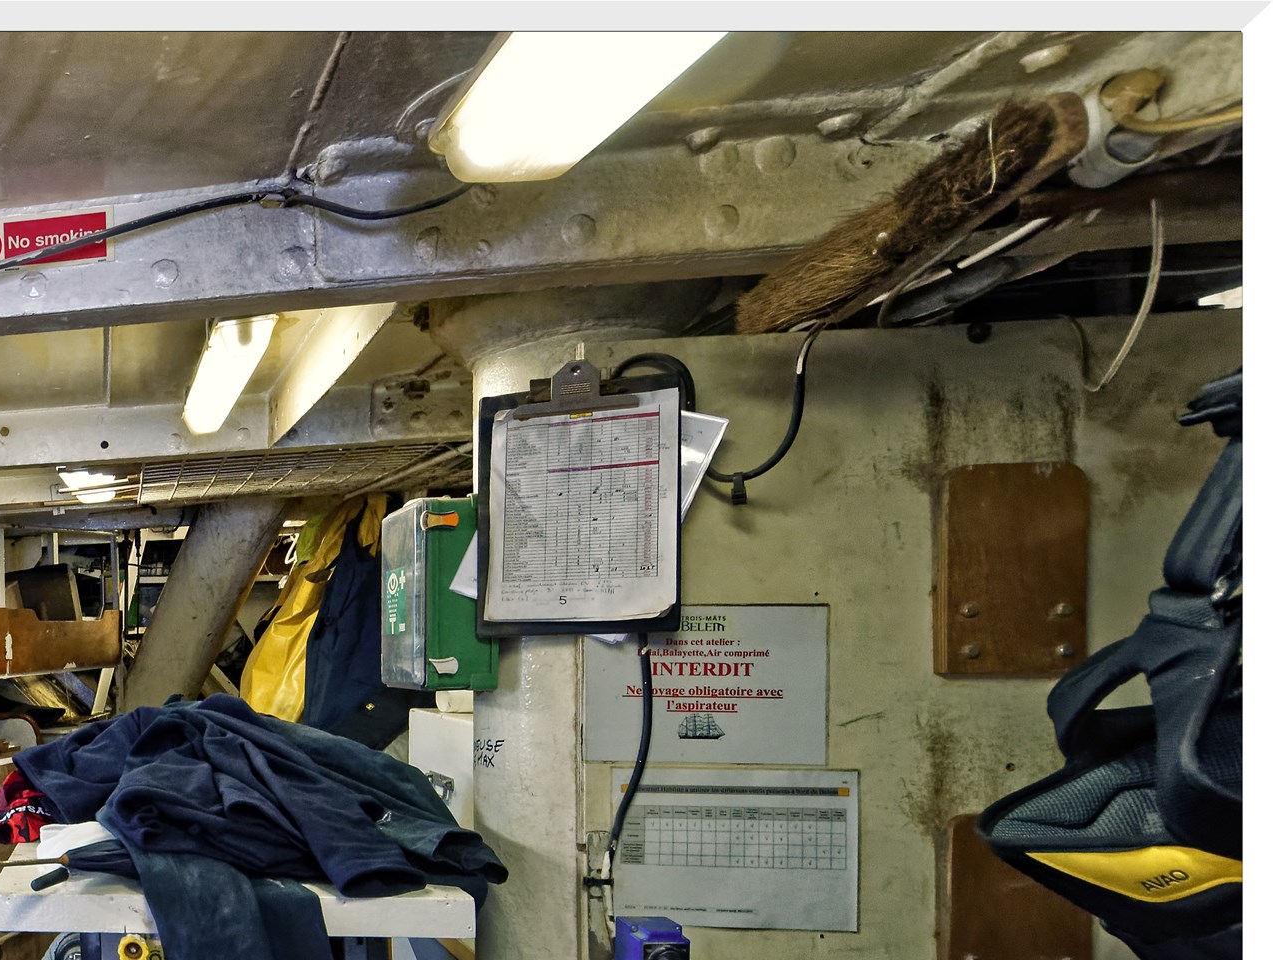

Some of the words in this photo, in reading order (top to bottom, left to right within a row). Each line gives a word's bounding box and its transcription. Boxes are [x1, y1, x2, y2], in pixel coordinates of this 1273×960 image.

[8, 235, 31, 250] No
[558, 595, 568, 606] 5
[666, 638, 689, 646] Dans
[690, 638, 704, 646] cet
[705, 638, 735, 646] atelier
[724, 649, 770, 659] comprimé
[652, 662, 755, 677] INTERDIT
[626, 685, 685, 699] Neoyage
[688, 685, 753, 698] obligatoire
[756, 687, 783, 697] avec
[1140, 869, 1190, 892] AVAO
